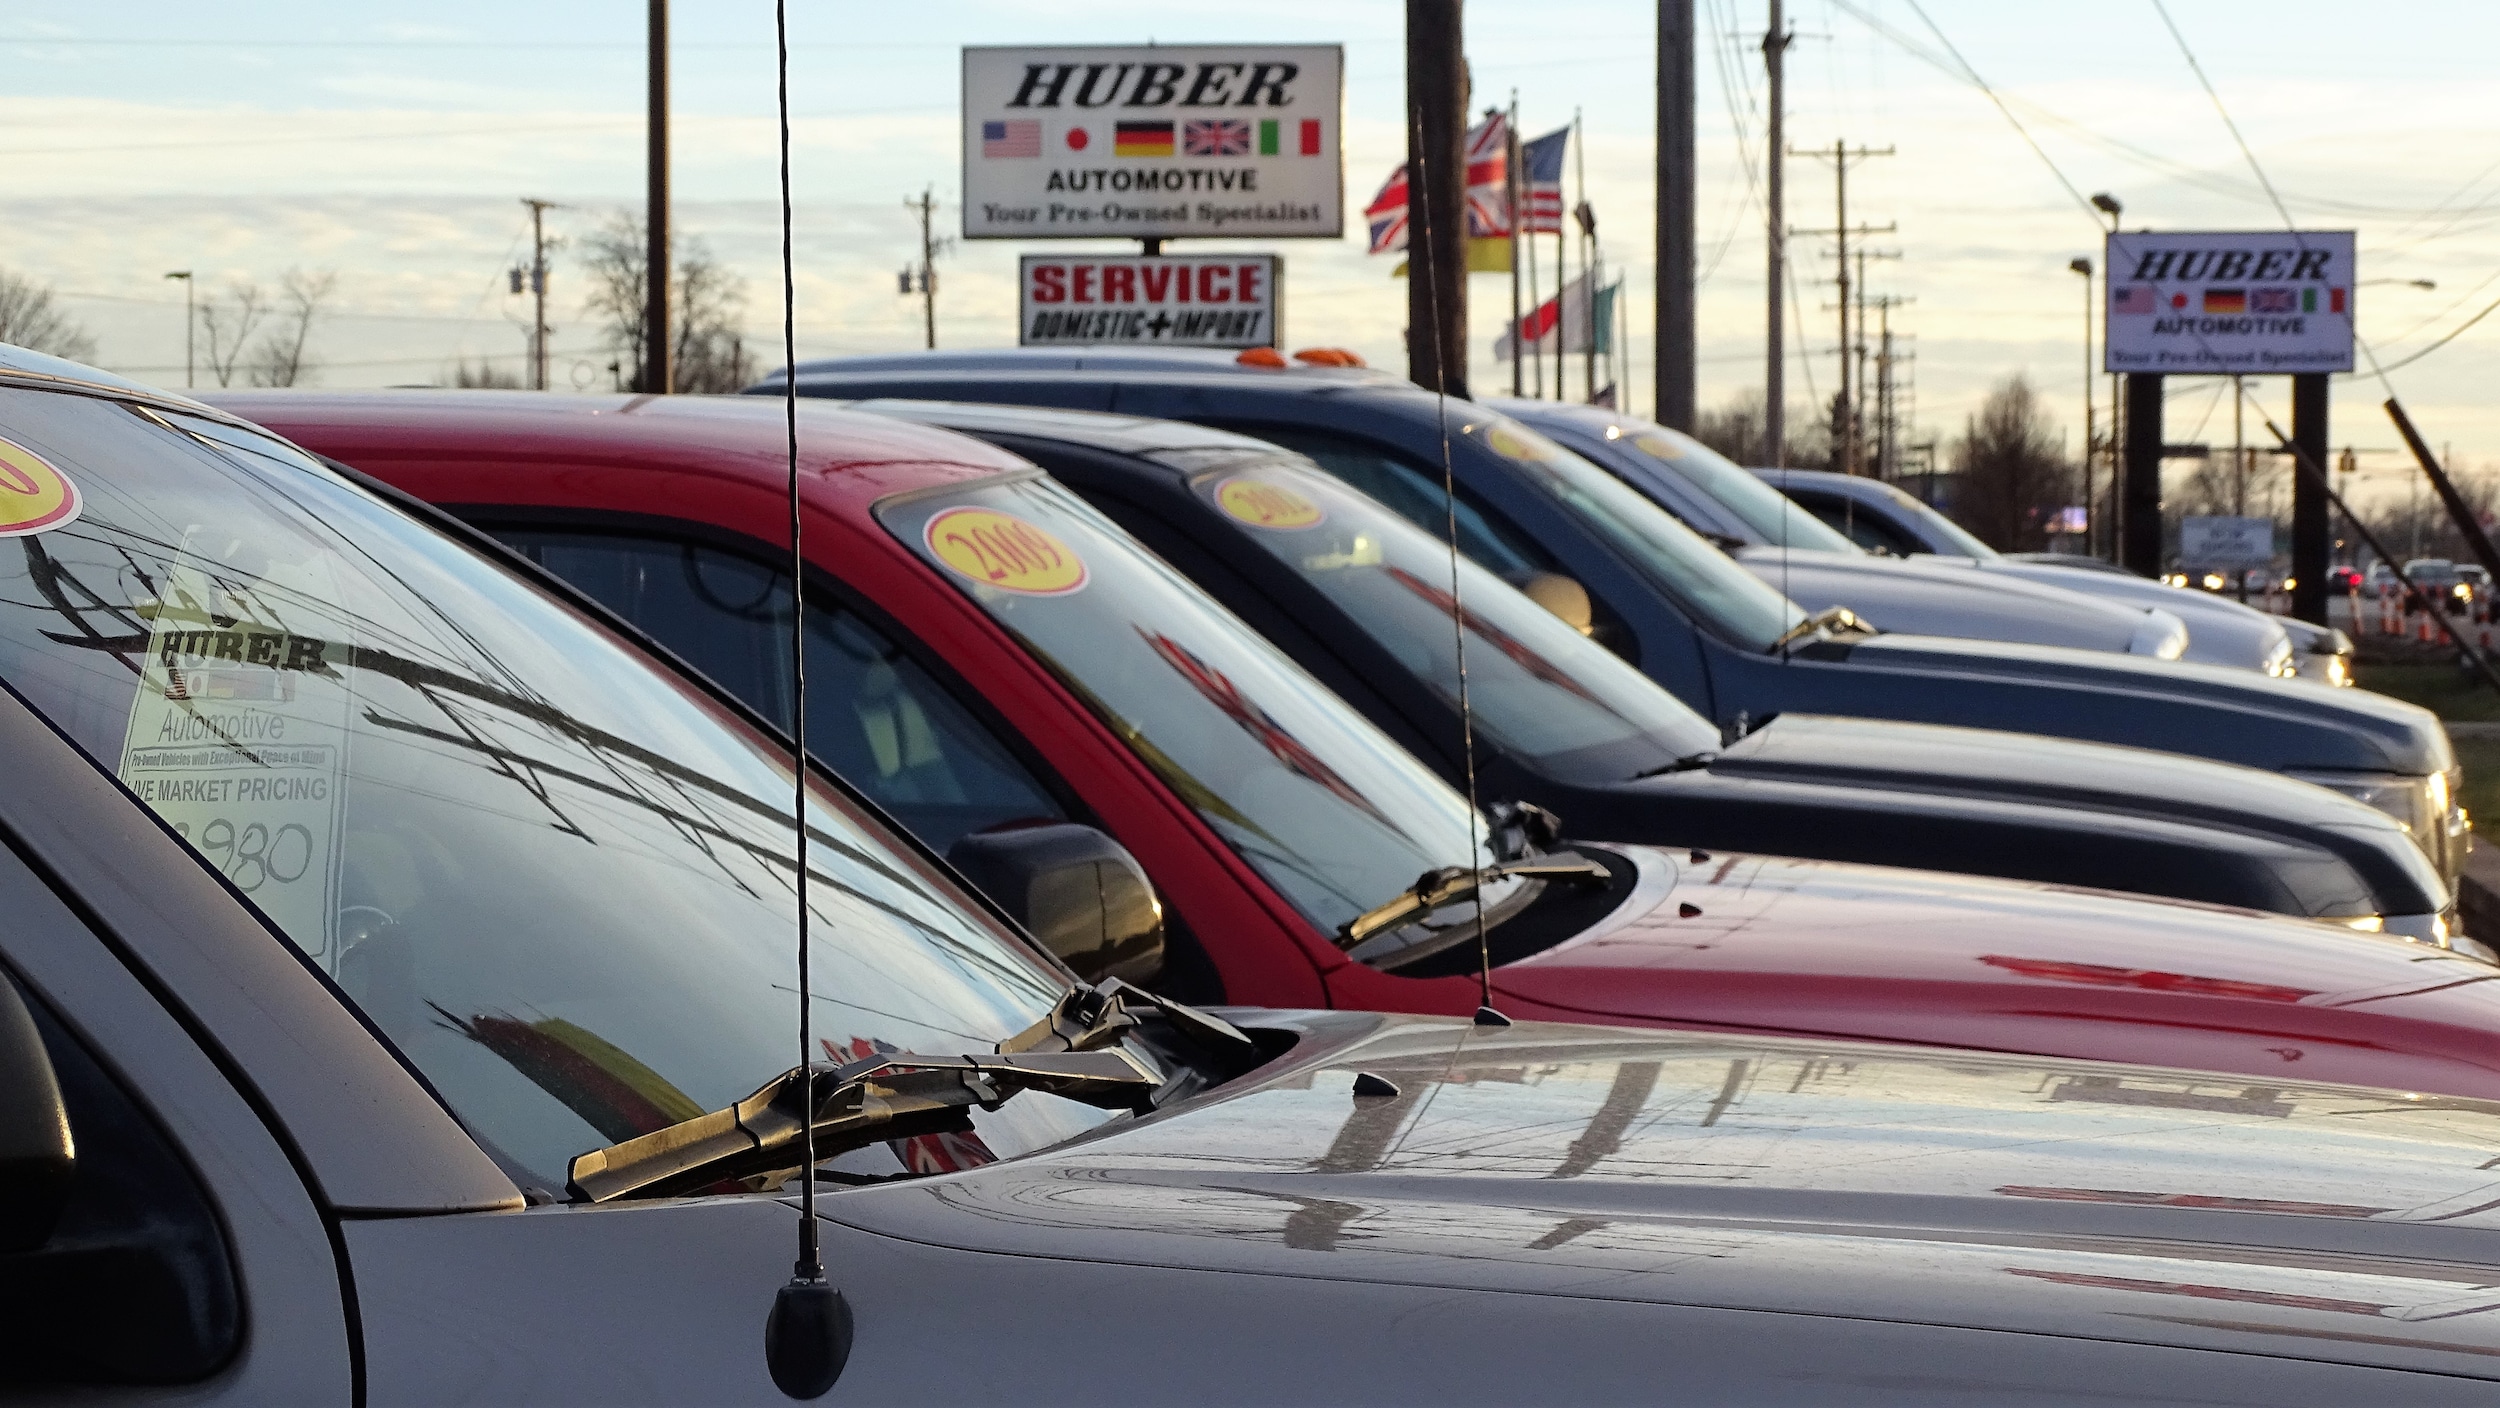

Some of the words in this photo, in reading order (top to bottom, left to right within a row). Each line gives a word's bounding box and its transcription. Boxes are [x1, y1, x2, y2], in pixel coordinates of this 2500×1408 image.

[1005, 62, 1299, 108] HUBER
[1046, 168, 1258, 192] AUTOMOTIVE
[983, 202, 1040, 222] Your
[1048, 202, 1189, 222] Pre-Owned
[1197, 202, 1321, 227] Specialist
[2131, 249, 2332, 281] HUBER
[1031, 264, 1262, 304] SERVICE
[2152, 317, 2306, 335] AUTOMOTIVE
[945, 519, 1063, 581] 2009
[156, 630, 328, 672] HUBER
[158, 708, 285, 742] Automotive
[158, 779, 233, 802] MARKET
[237, 777, 327, 802] PRICING
[173, 818, 313, 893] 980
